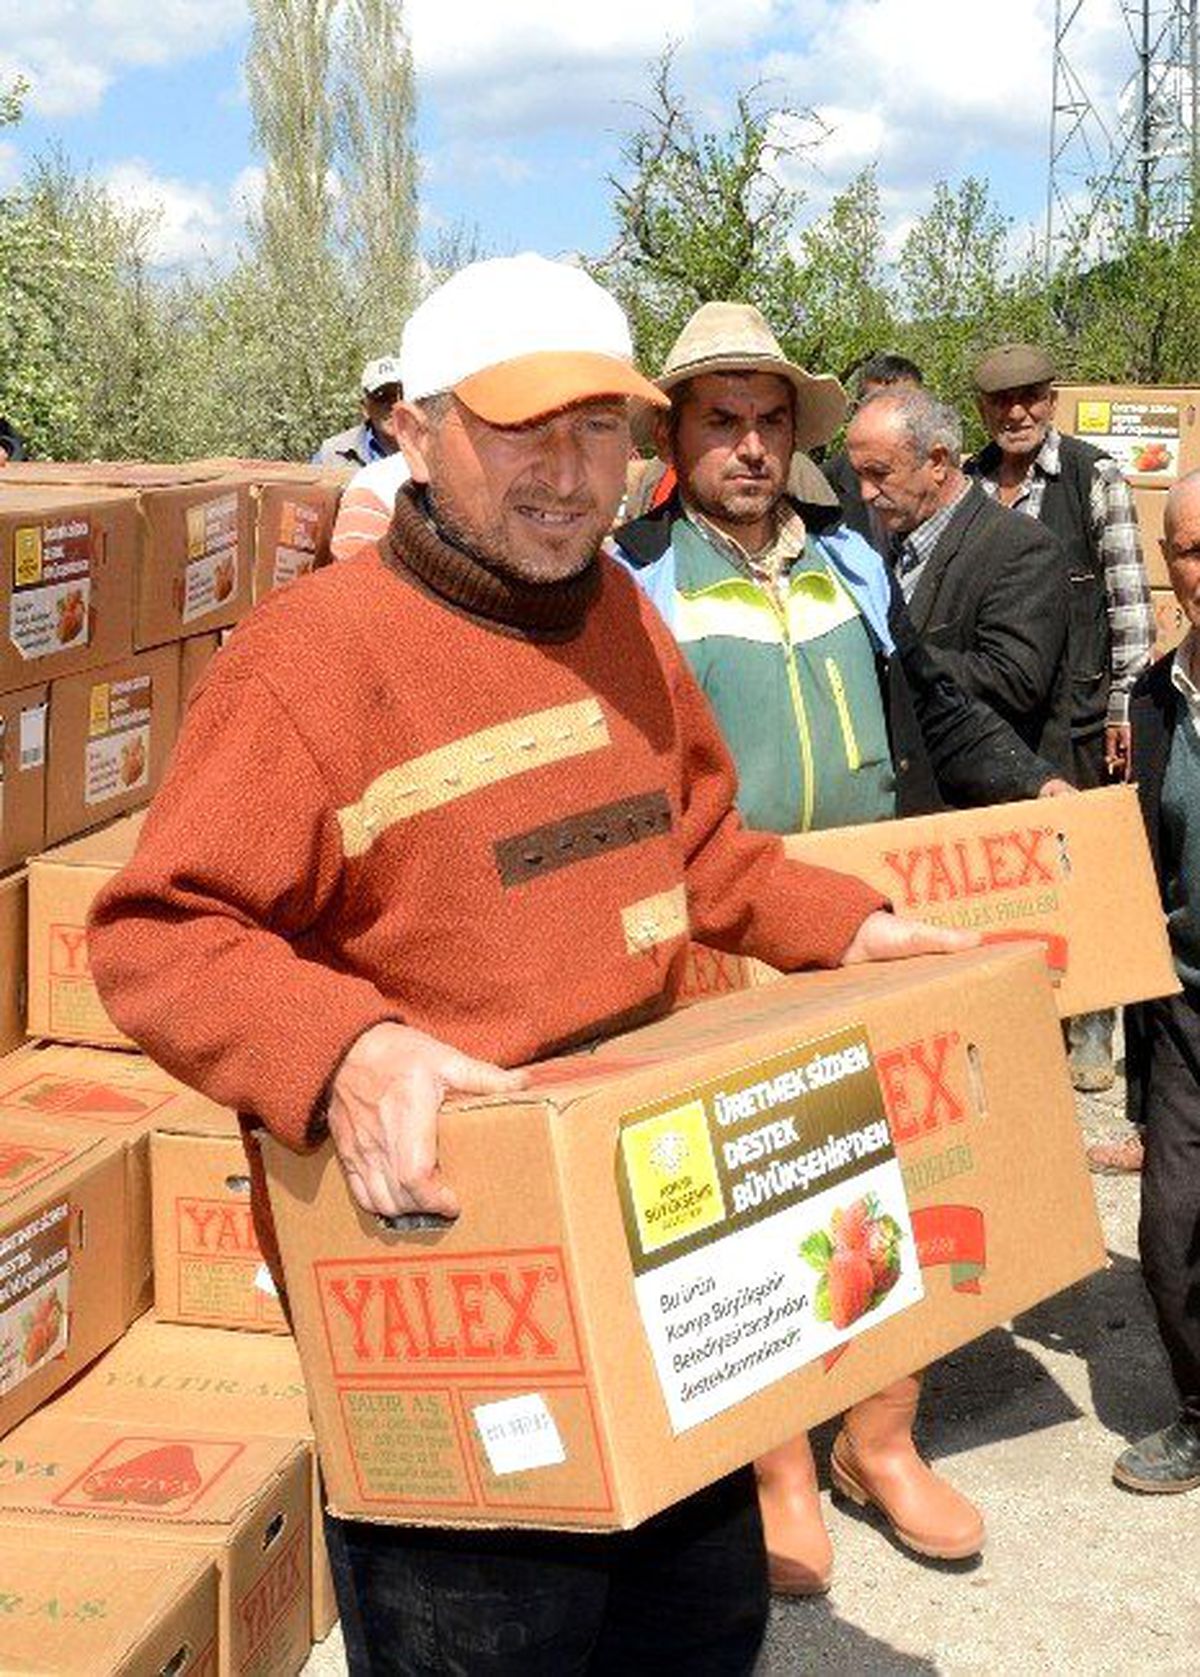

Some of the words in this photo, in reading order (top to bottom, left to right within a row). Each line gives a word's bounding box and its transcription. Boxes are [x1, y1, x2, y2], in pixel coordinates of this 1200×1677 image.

[884, 829, 1055, 906] YALEX
[715, 1065, 803, 1126] ÜRETMEK
[879, 1035, 963, 1144] EX
[722, 1117, 800, 1170] DESTEK
[184, 1205, 259, 1250] YAL
[330, 1269, 557, 1360] YALEX
